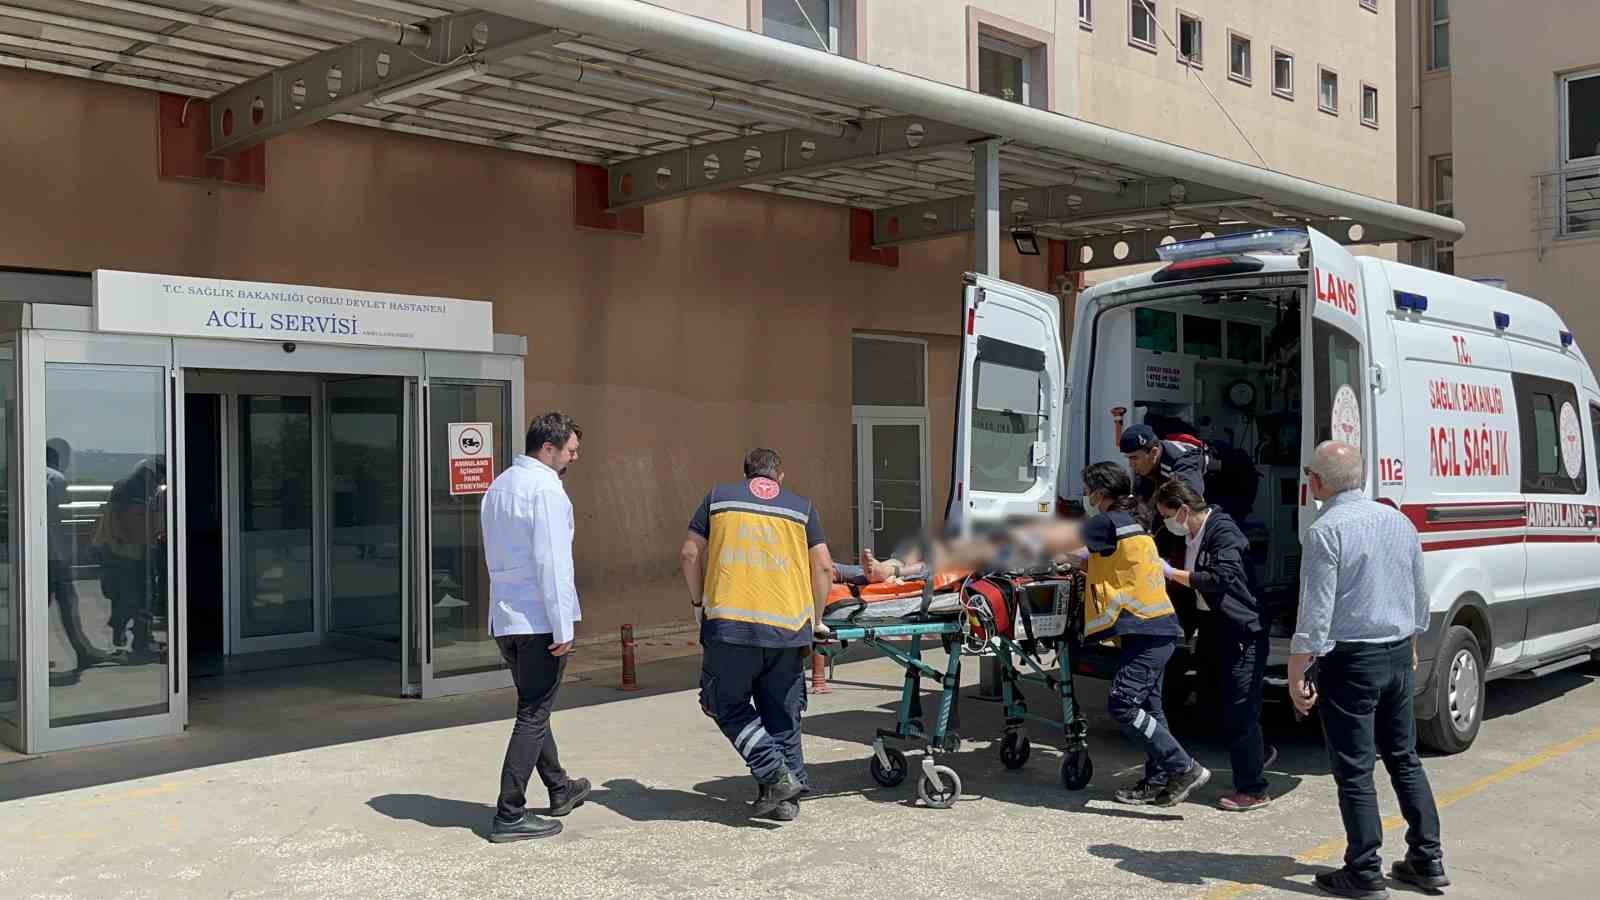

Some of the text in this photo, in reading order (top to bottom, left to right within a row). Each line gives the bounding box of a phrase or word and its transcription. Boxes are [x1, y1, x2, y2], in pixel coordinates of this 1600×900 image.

[188, 285, 234, 298] SAĞLIK
[238, 289, 304, 303] BAKANLIĞI
[306, 295, 344, 305] ÇORLU
[346, 298, 386, 309] DEVLET
[389, 302, 446, 313] HASTANESİ
[206, 307, 263, 328] ACİL
[270, 312, 360, 336] SERVİSİ
[1430, 377, 1504, 414] SAĞLIK BAKANLIĞI
[1464, 423, 1509, 476] SAĞLIK
[1380, 458, 1403, 481] 112
[1528, 503, 1585, 527] AMBULANS
